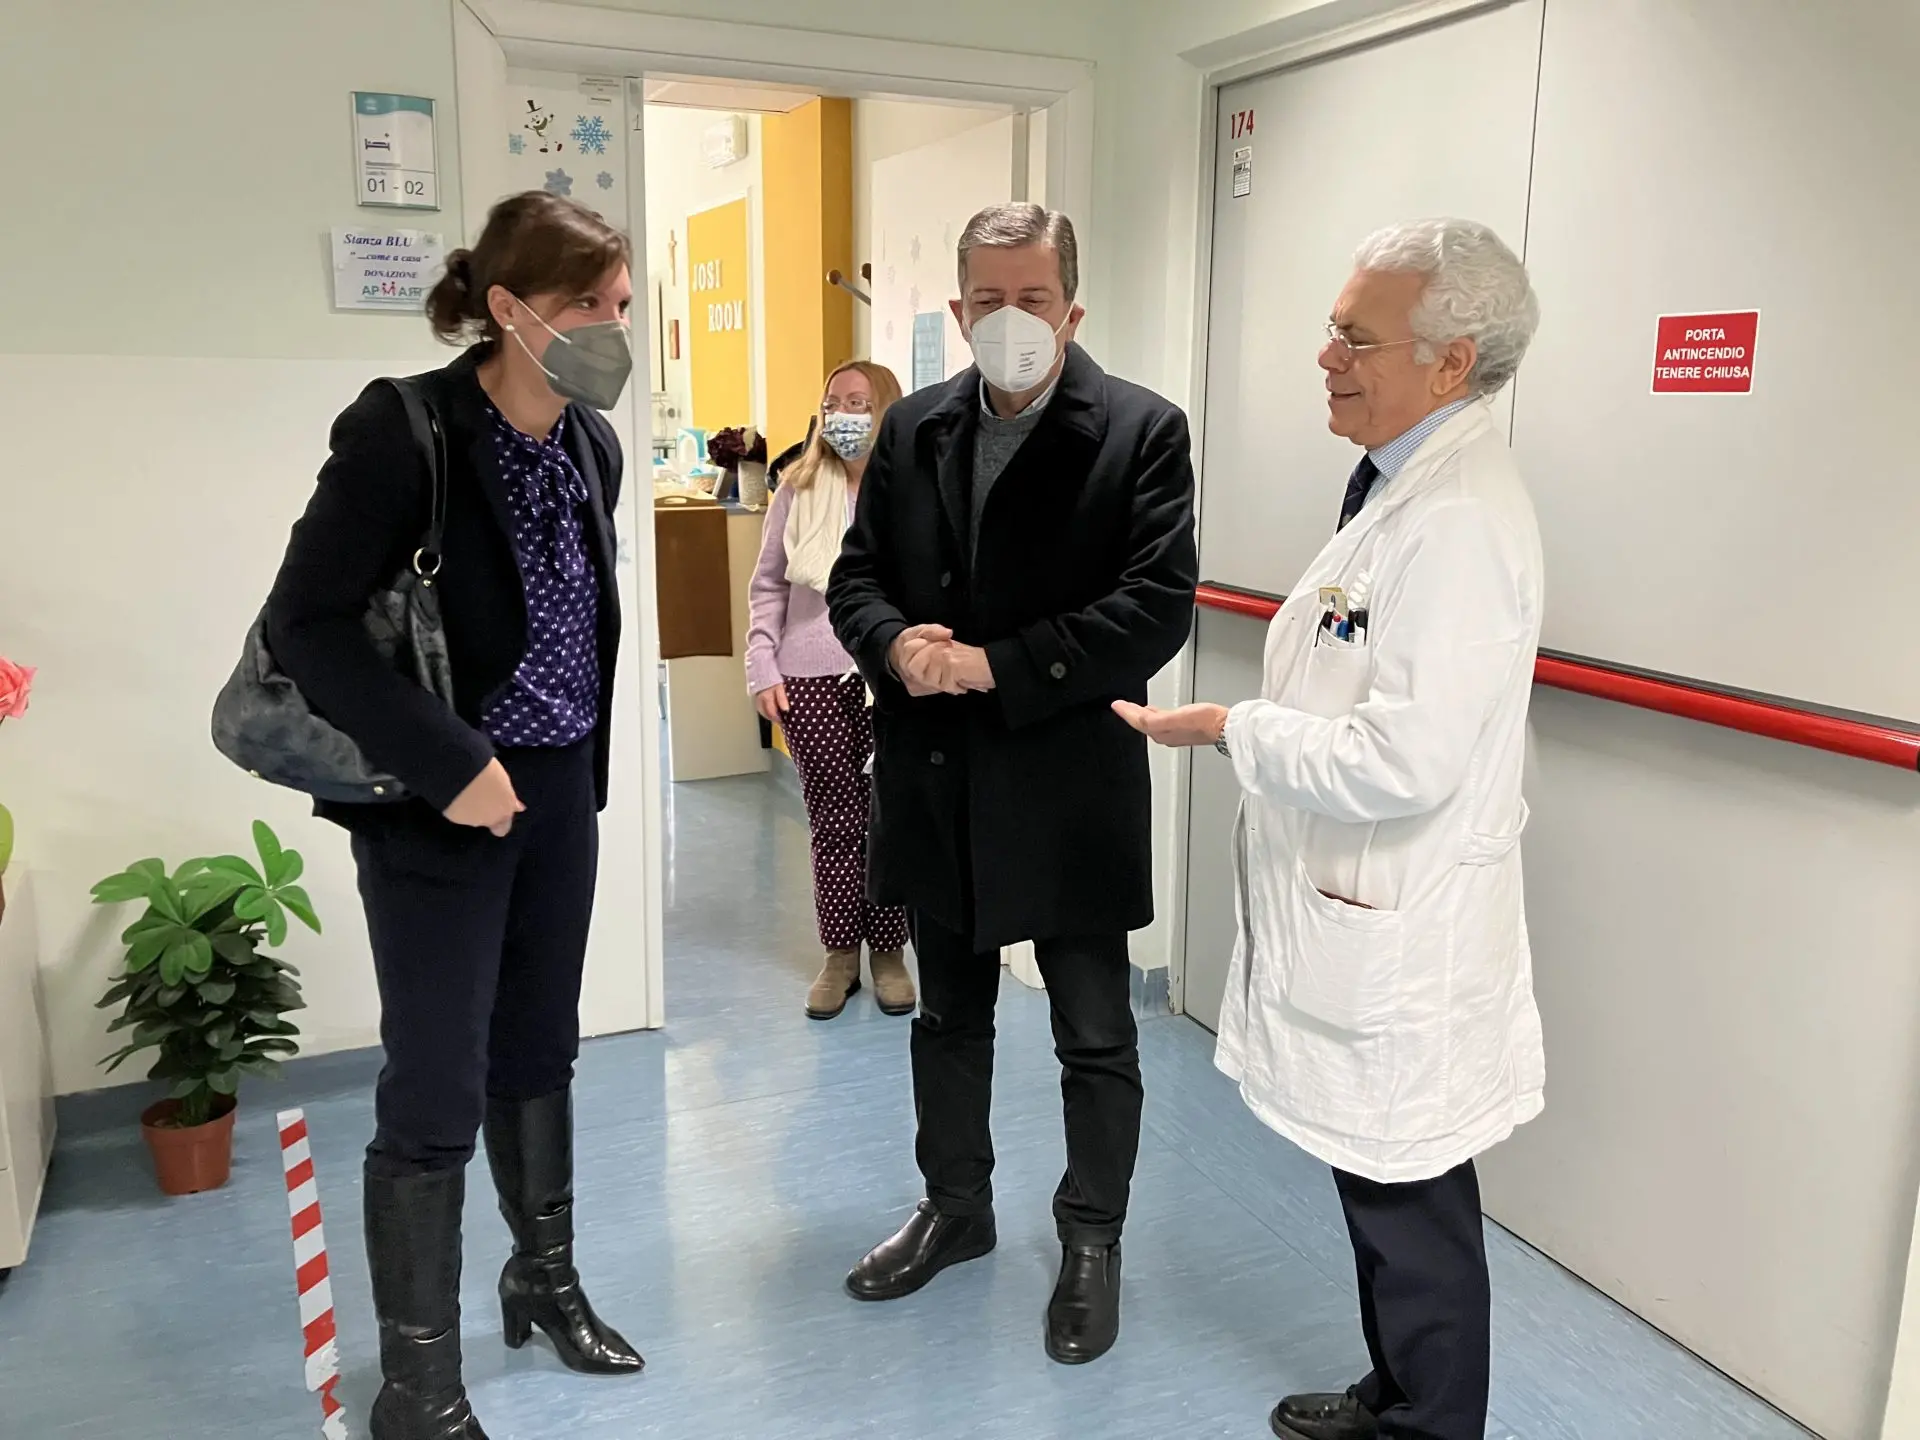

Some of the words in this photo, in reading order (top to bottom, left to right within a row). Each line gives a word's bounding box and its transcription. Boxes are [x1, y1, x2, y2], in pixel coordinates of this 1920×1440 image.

[1231, 109, 1254, 140] 174
[367, 178, 385, 193] 01
[404, 180, 424, 195] 02
[343, 233, 382, 246] Stanza
[385, 236, 413, 247] BLU
[363, 269, 418, 279] DONAZIONE
[692, 259, 721, 292] JOSI
[708, 300, 743, 332] ROOM
[1685, 328, 1725, 342] PORTA
[1663, 346, 1745, 361] ANTINCENDIO
[1655, 366, 1702, 379] TENERE
[1704, 365, 1750, 379] CHIUSA
